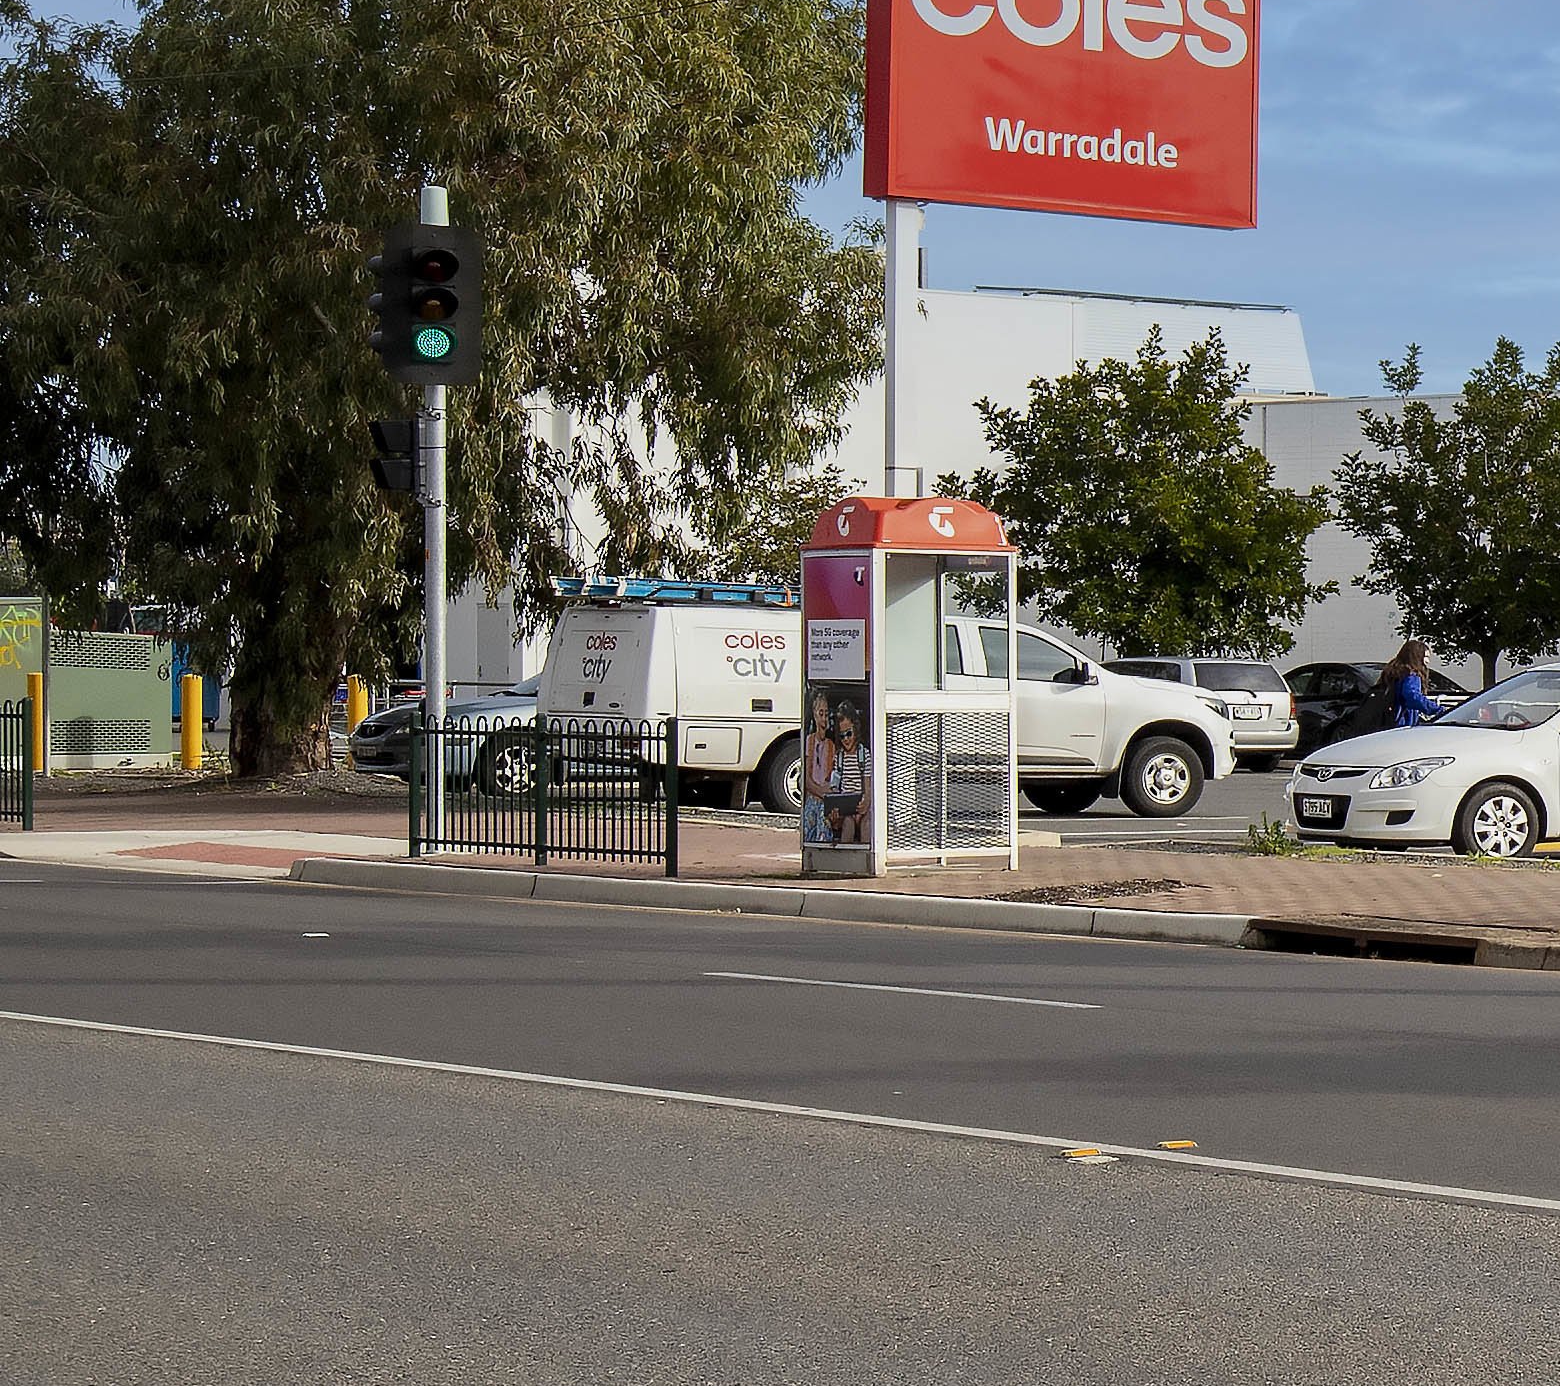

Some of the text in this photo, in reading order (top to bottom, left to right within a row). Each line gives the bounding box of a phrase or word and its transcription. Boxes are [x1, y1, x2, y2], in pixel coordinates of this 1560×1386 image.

[984, 116, 1179, 169] Warradale
[586, 631, 618, 651] coles
[724, 631, 786, 650] coles
